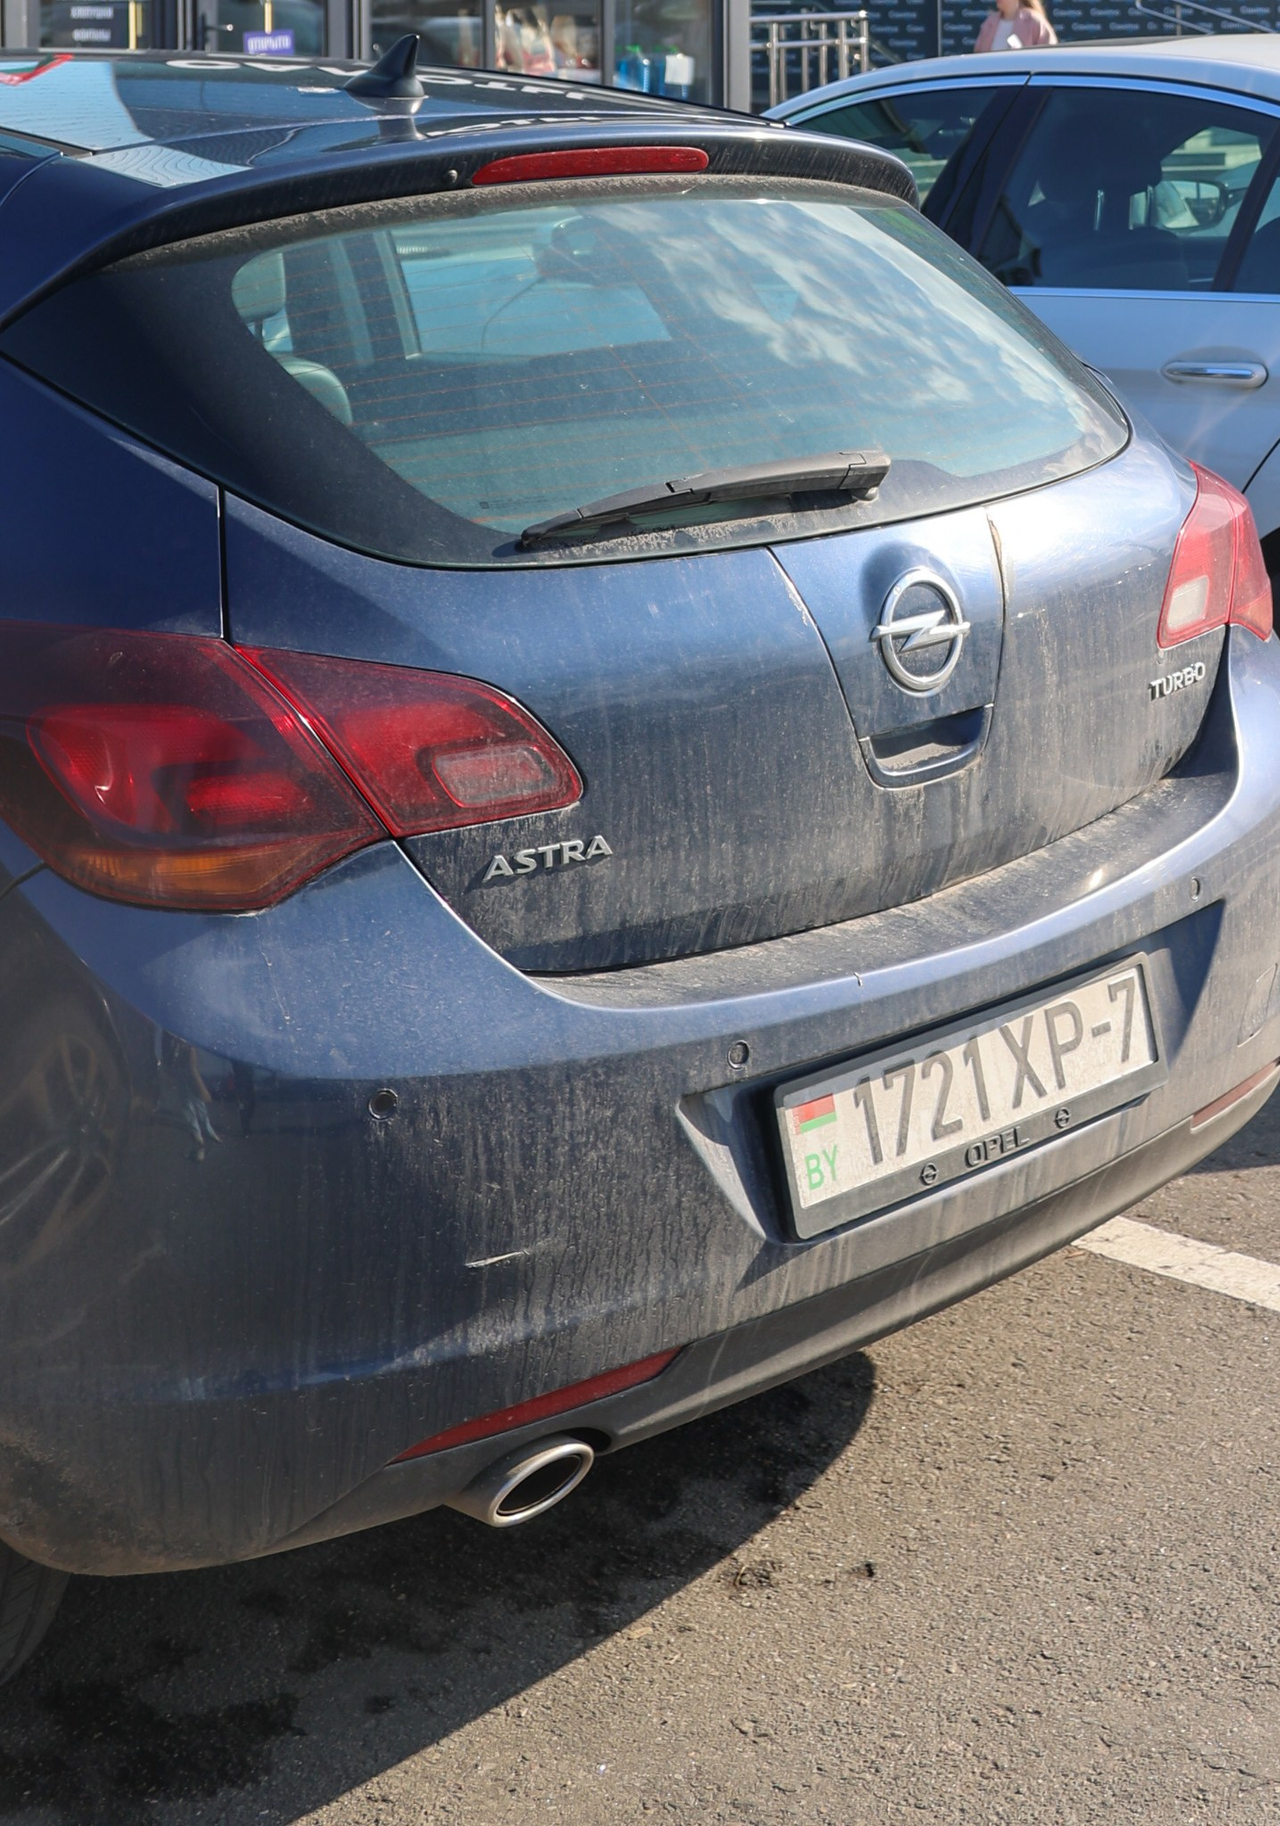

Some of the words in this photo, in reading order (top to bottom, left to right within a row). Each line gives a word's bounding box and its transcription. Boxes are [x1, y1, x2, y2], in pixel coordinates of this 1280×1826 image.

[1147, 660, 1207, 701] TURBO
[481, 834, 614, 883] ASTRA
[803, 1143, 840, 1192] BY
[963, 1124, 1031, 1169] OPEL
